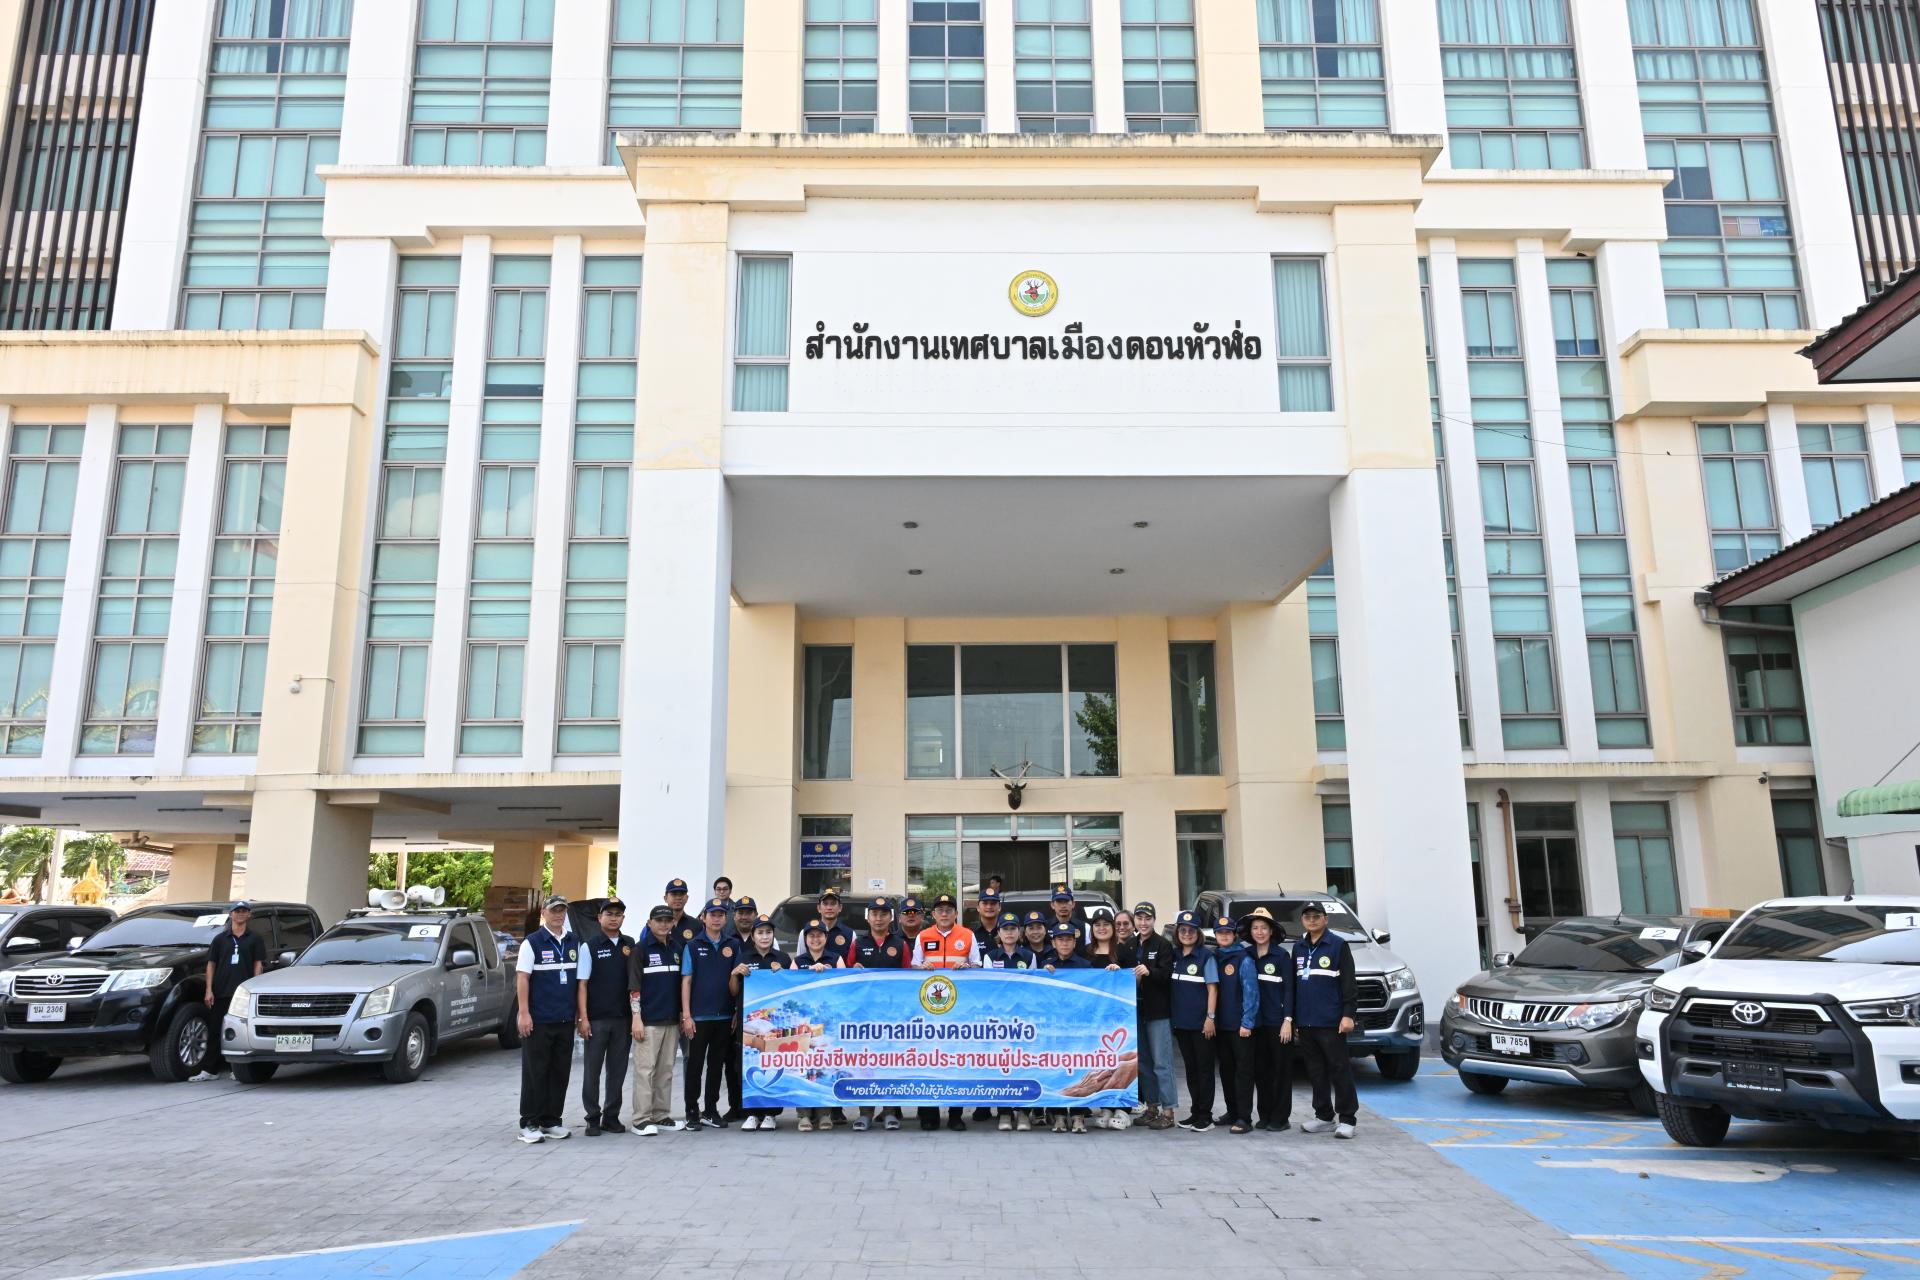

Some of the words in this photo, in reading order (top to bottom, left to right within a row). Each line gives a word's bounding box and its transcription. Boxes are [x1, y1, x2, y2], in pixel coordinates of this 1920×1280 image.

[805, 320, 1262, 360] สำนักงานเทศบาลเมืองดอนหัวฬ่อ
[207, 916, 217, 924] 7
[1904, 915, 1917, 926] 1
[419, 926, 430, 936] 6
[1651, 929, 1666, 938] 2
[46, 1005, 64, 1014] 2306
[840, 1018, 1035, 1040] เทศบาลเมืองดอนหัวฬ่อ
[1509, 1036, 1529, 1048] 7854
[761, 1048, 1117, 1074] มอบถุงยังชีพช่วยเหลือประชาชนผู้ประสบอุทกภัย
